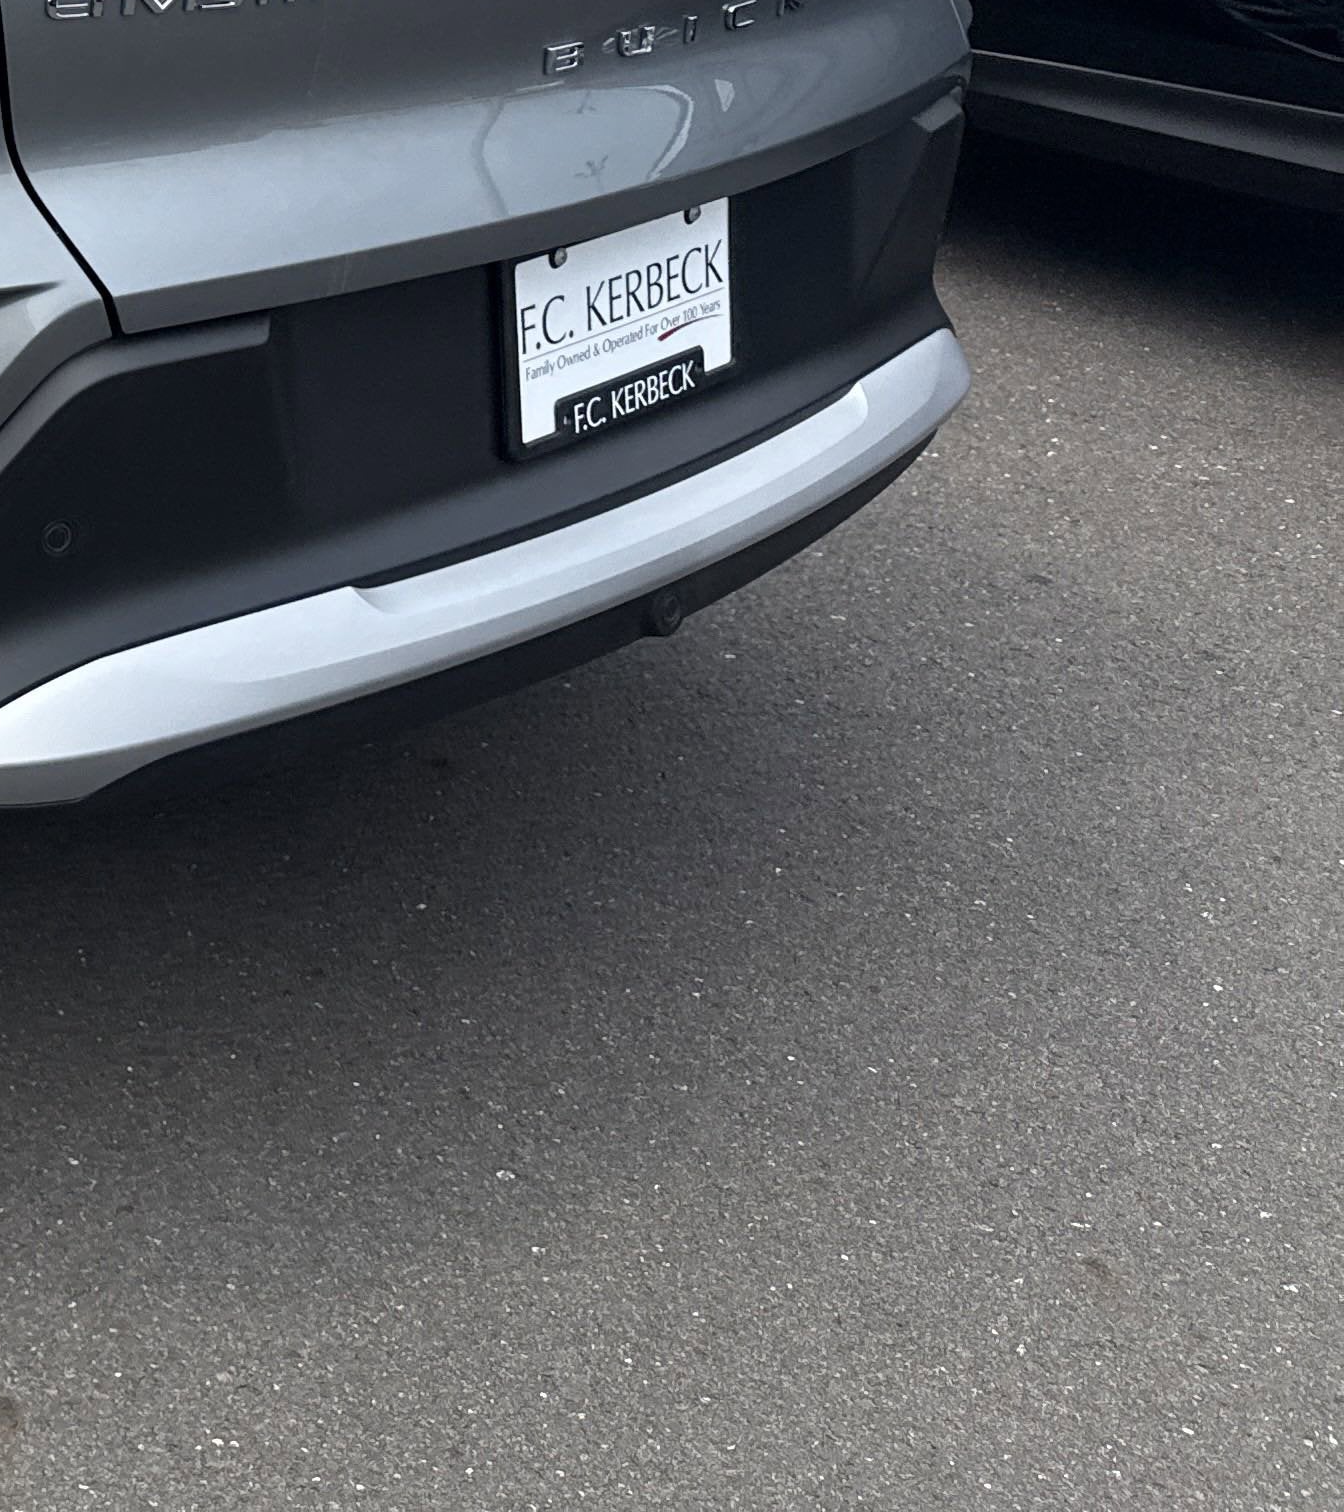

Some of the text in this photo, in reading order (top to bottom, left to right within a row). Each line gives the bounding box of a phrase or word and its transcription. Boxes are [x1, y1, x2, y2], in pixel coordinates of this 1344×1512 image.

[519, 239, 723, 355] F.C. KERBECK
[525, 300, 720, 381] Family Owned & Operated For Over 100 Years
[573, 360, 696, 434] F.C. KERBECK
